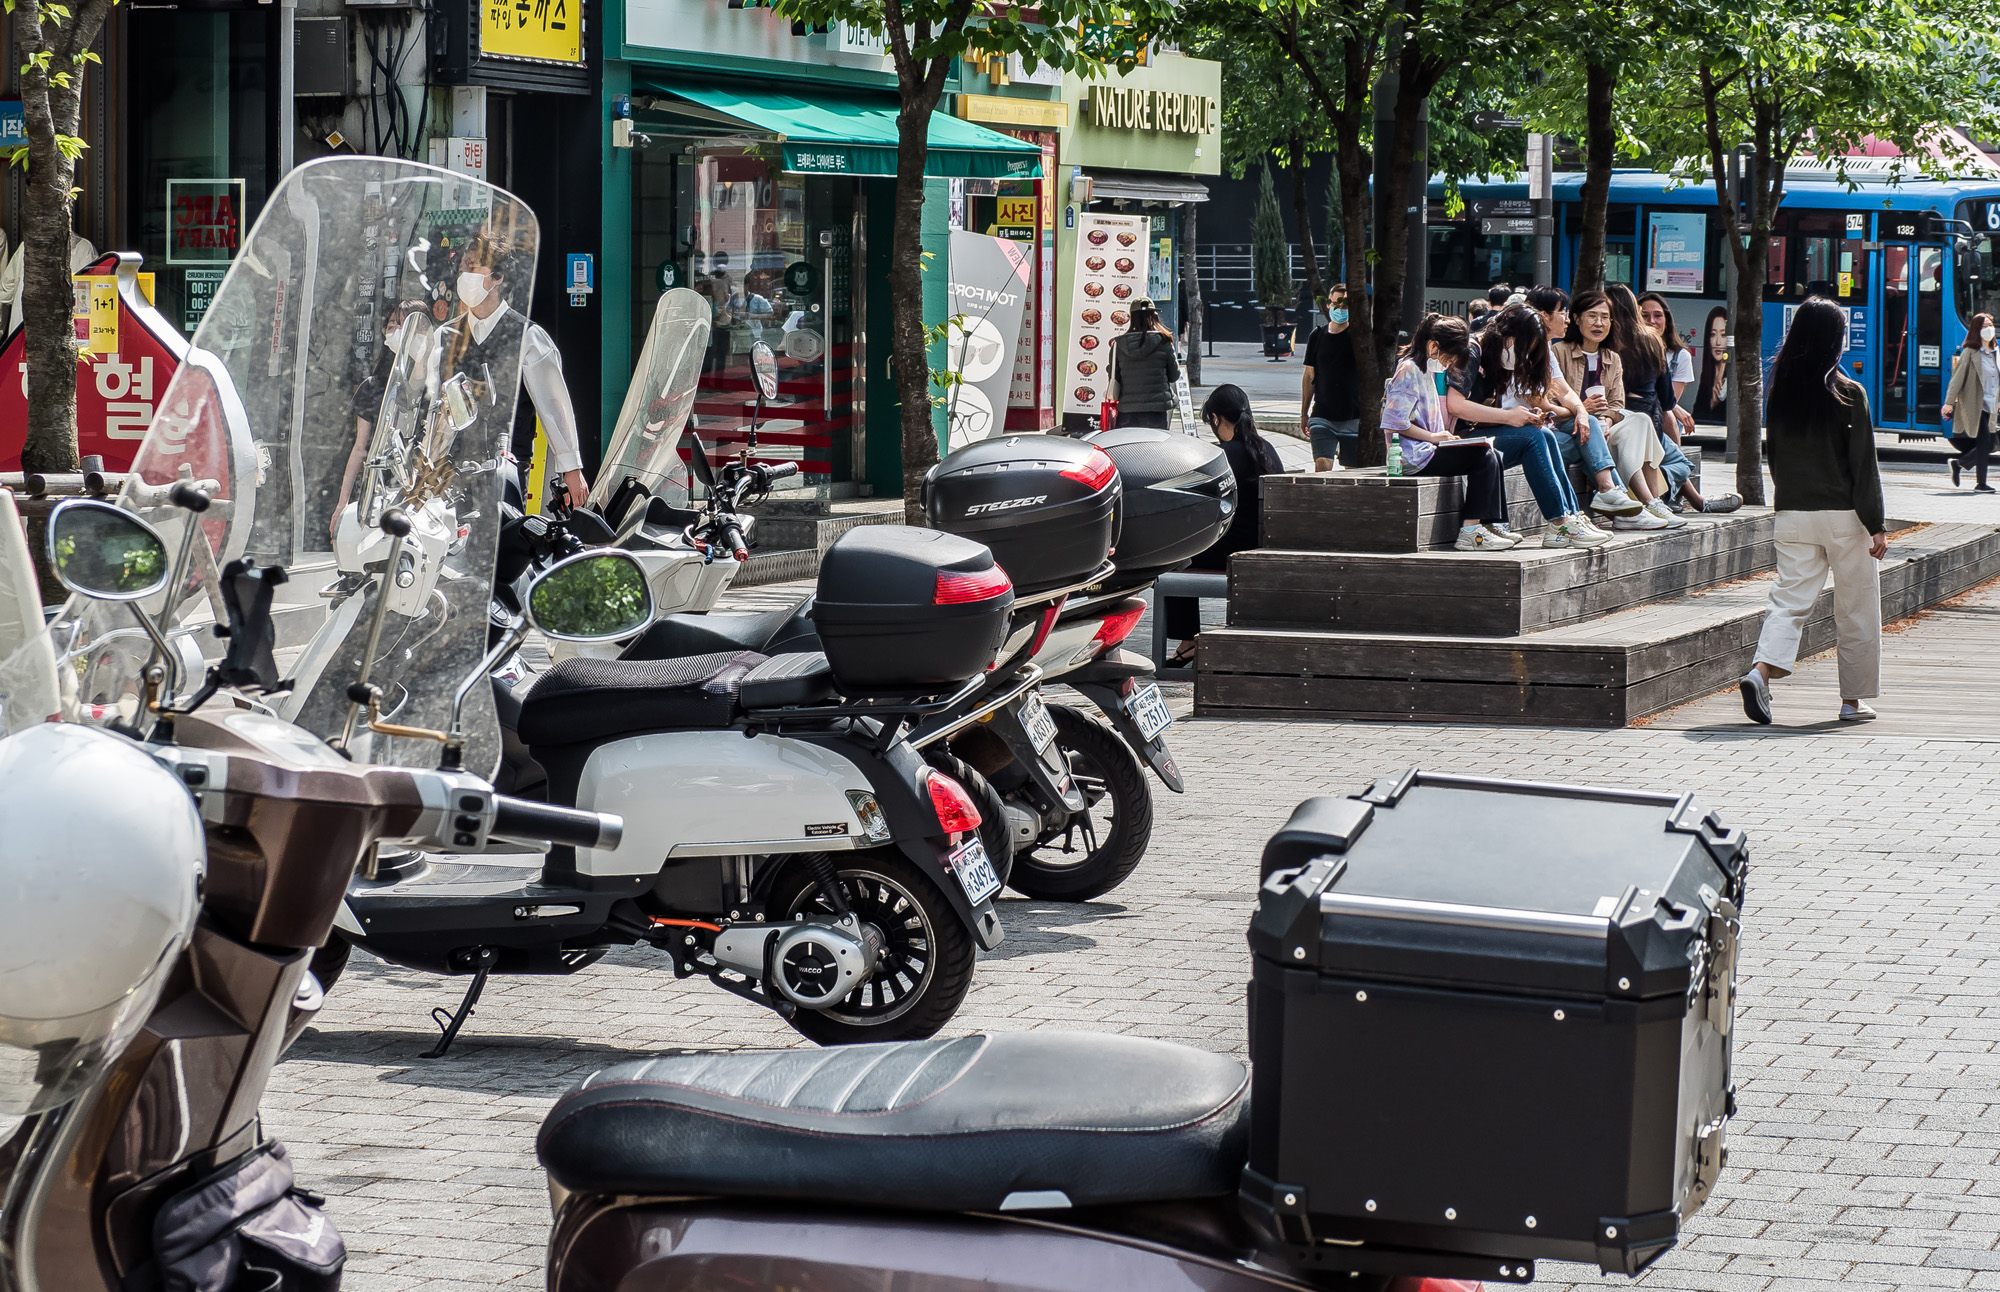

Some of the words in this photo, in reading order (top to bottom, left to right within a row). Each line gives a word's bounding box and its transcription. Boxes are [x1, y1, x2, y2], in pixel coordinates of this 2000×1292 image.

[1095, 85, 1152, 130] NATURE
[1156, 90, 1216, 135] REPUBLIC
[1000, 203, 1034, 223] 사진
[1847, 215, 1863, 229] 674
[1897, 225, 1915, 236] 1382
[94, 297, 114, 311] 1+1
[964, 494, 1049, 517] STEEZER
[1142, 702, 1168, 731] 7511
[968, 860, 996, 893] 3492
[798, 966, 823, 974] WACCO
